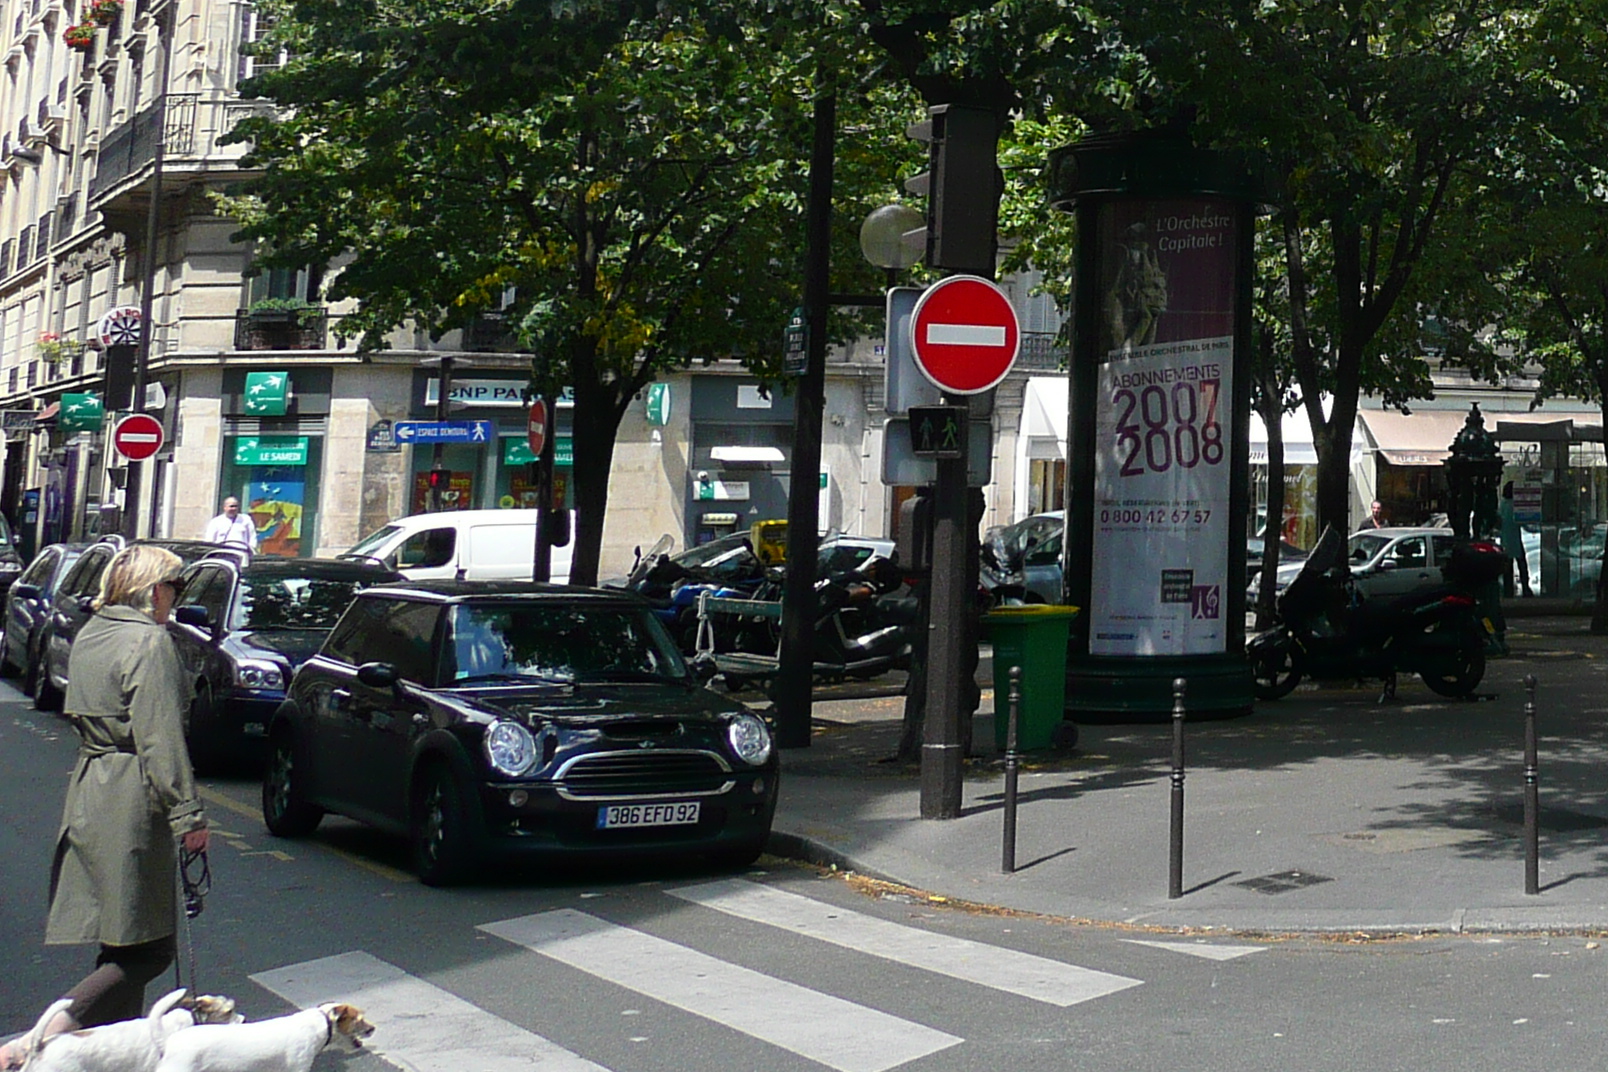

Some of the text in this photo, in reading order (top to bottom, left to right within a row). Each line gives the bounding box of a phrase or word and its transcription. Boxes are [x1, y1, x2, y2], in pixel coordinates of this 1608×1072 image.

[1156, 214, 1230, 232] L'Orchestre
[1112, 363, 1221, 389] ABONNEMENTS
[1112, 378, 1221, 434] 2007
[259, 452, 302, 461] LE SAMEDI
[1116, 421, 1224, 477] 2008
[1100, 508, 1211, 523] 0 800 42 67 57
[609, 807, 640, 825] 386
[676, 804, 697, 822] 92
